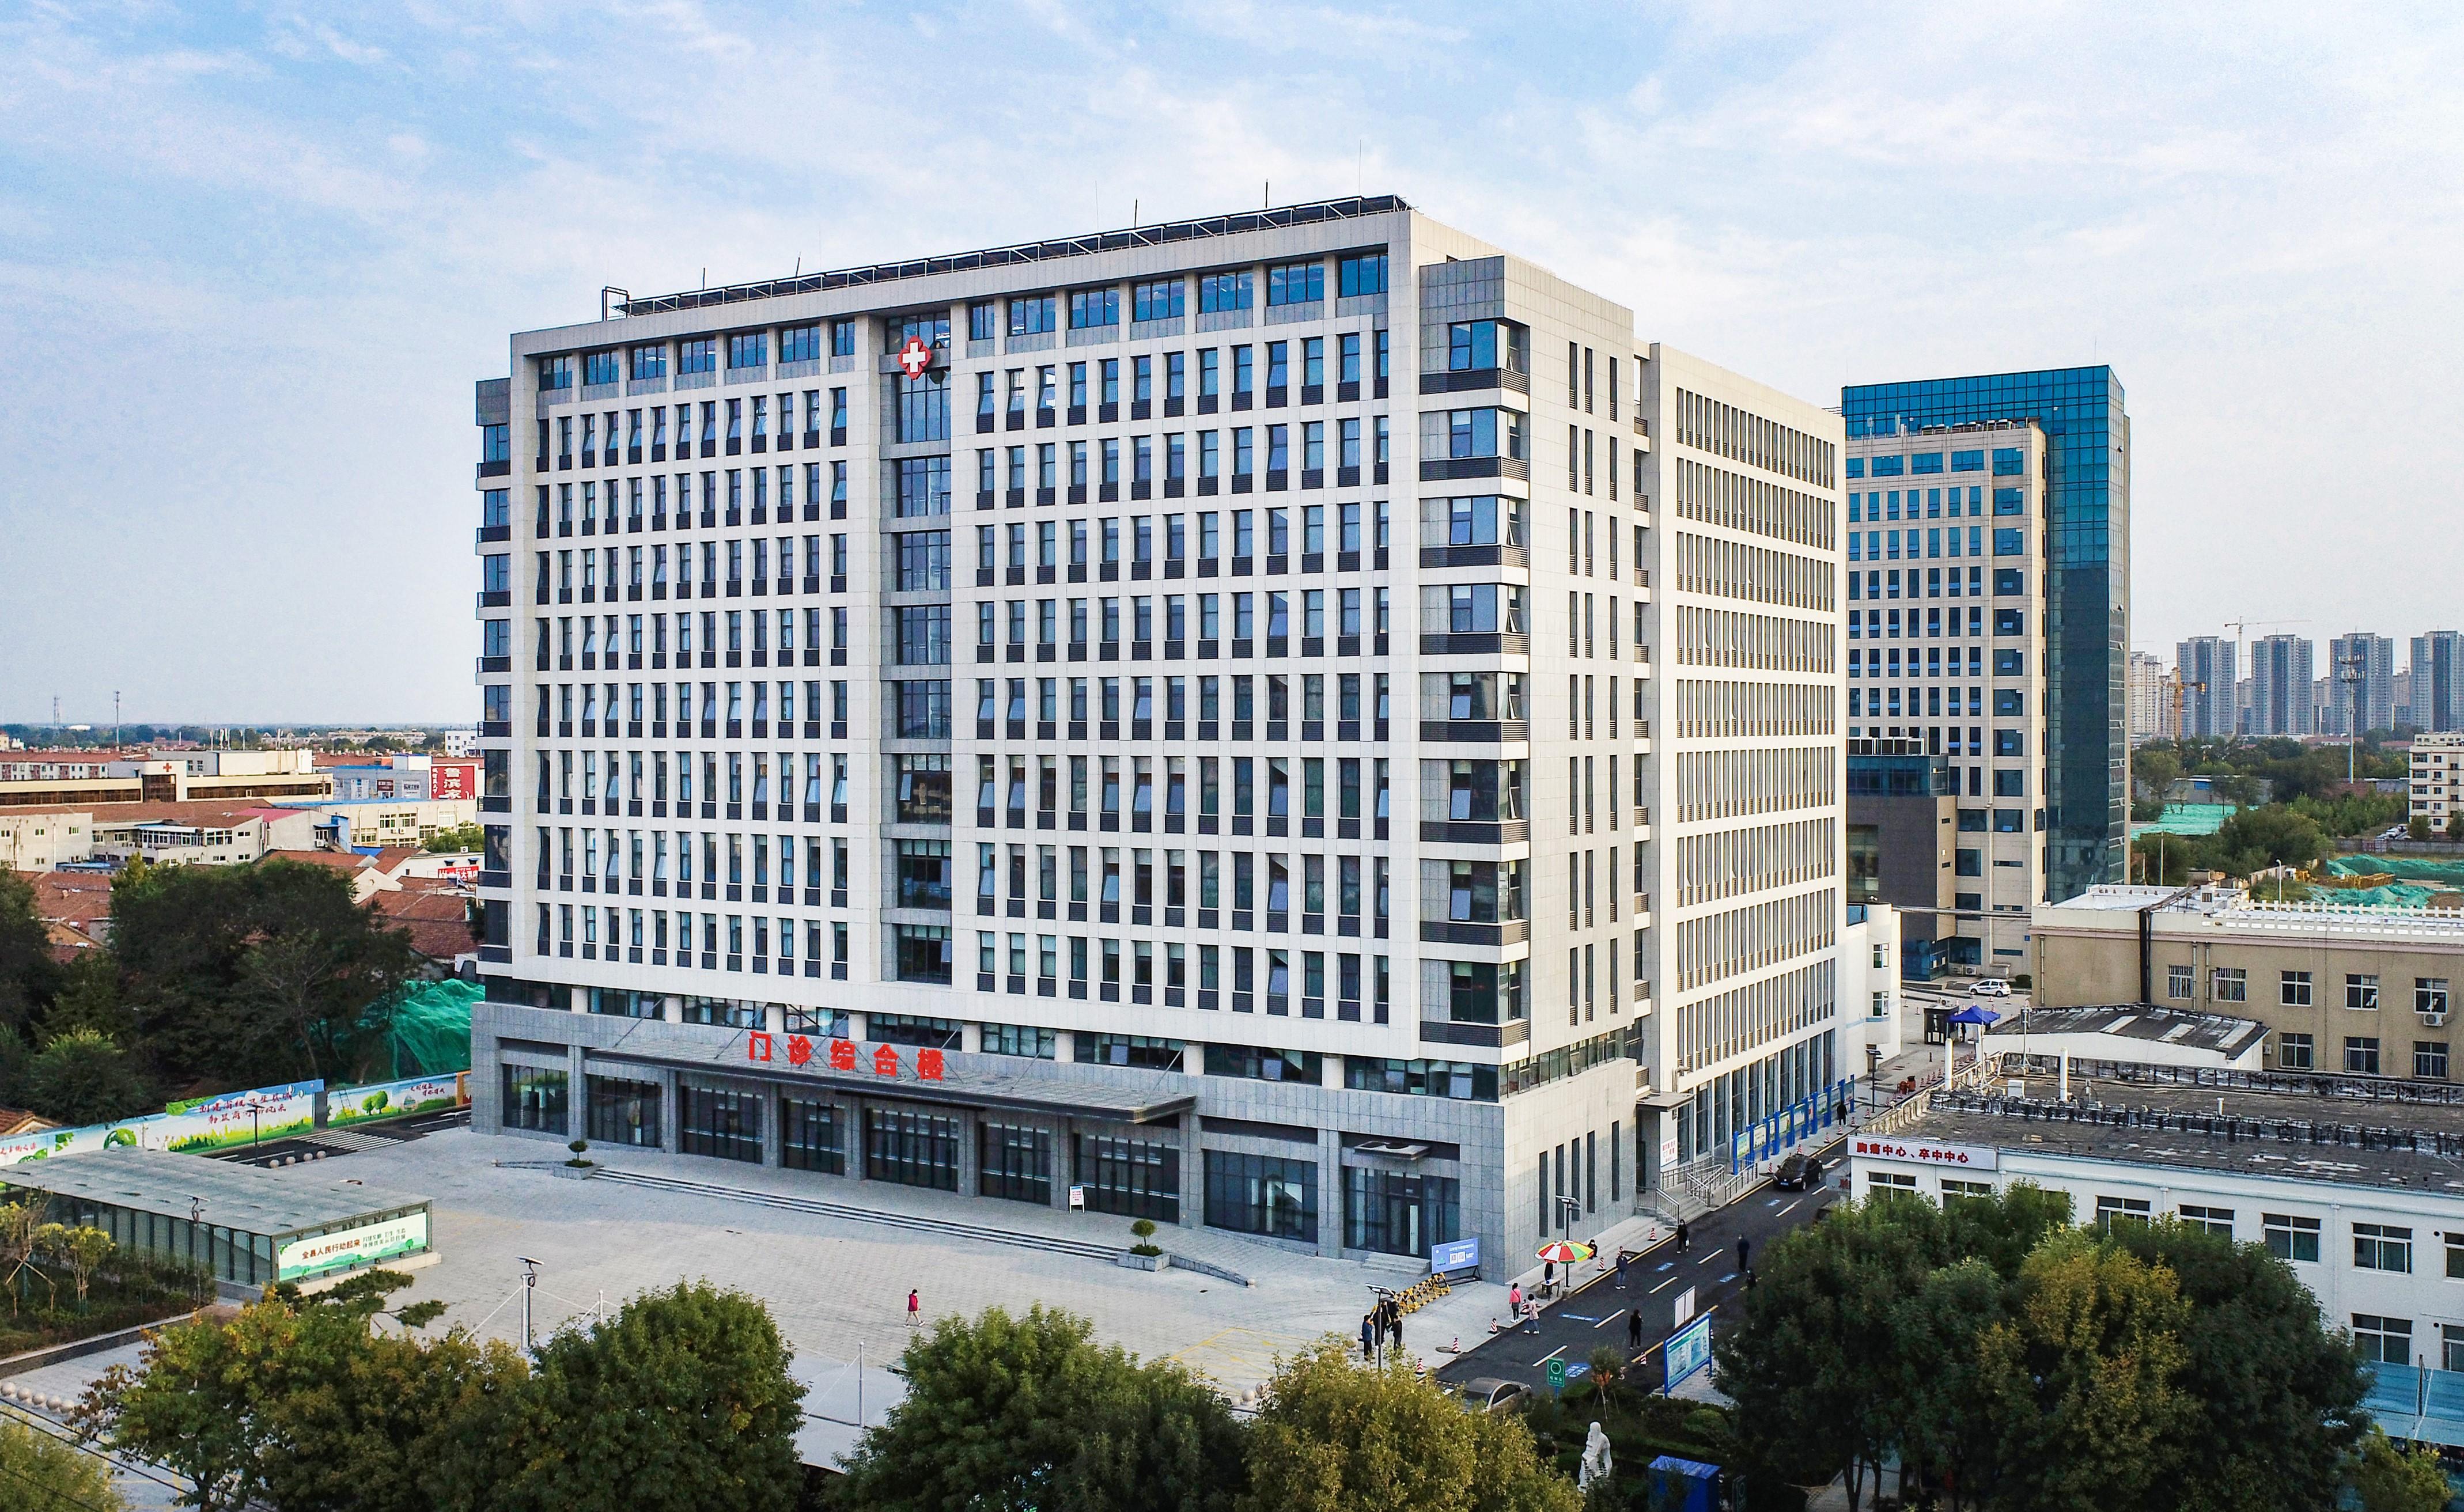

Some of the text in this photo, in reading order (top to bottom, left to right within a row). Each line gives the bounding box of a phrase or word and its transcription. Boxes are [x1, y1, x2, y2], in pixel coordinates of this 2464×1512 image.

[748, 1030, 944, 1081] 门诊综合楼
[1856, 1142, 1969, 1164] 胸痛中心、卒中中心
[301, 1238, 361, 1260] 全县人民行动起来
